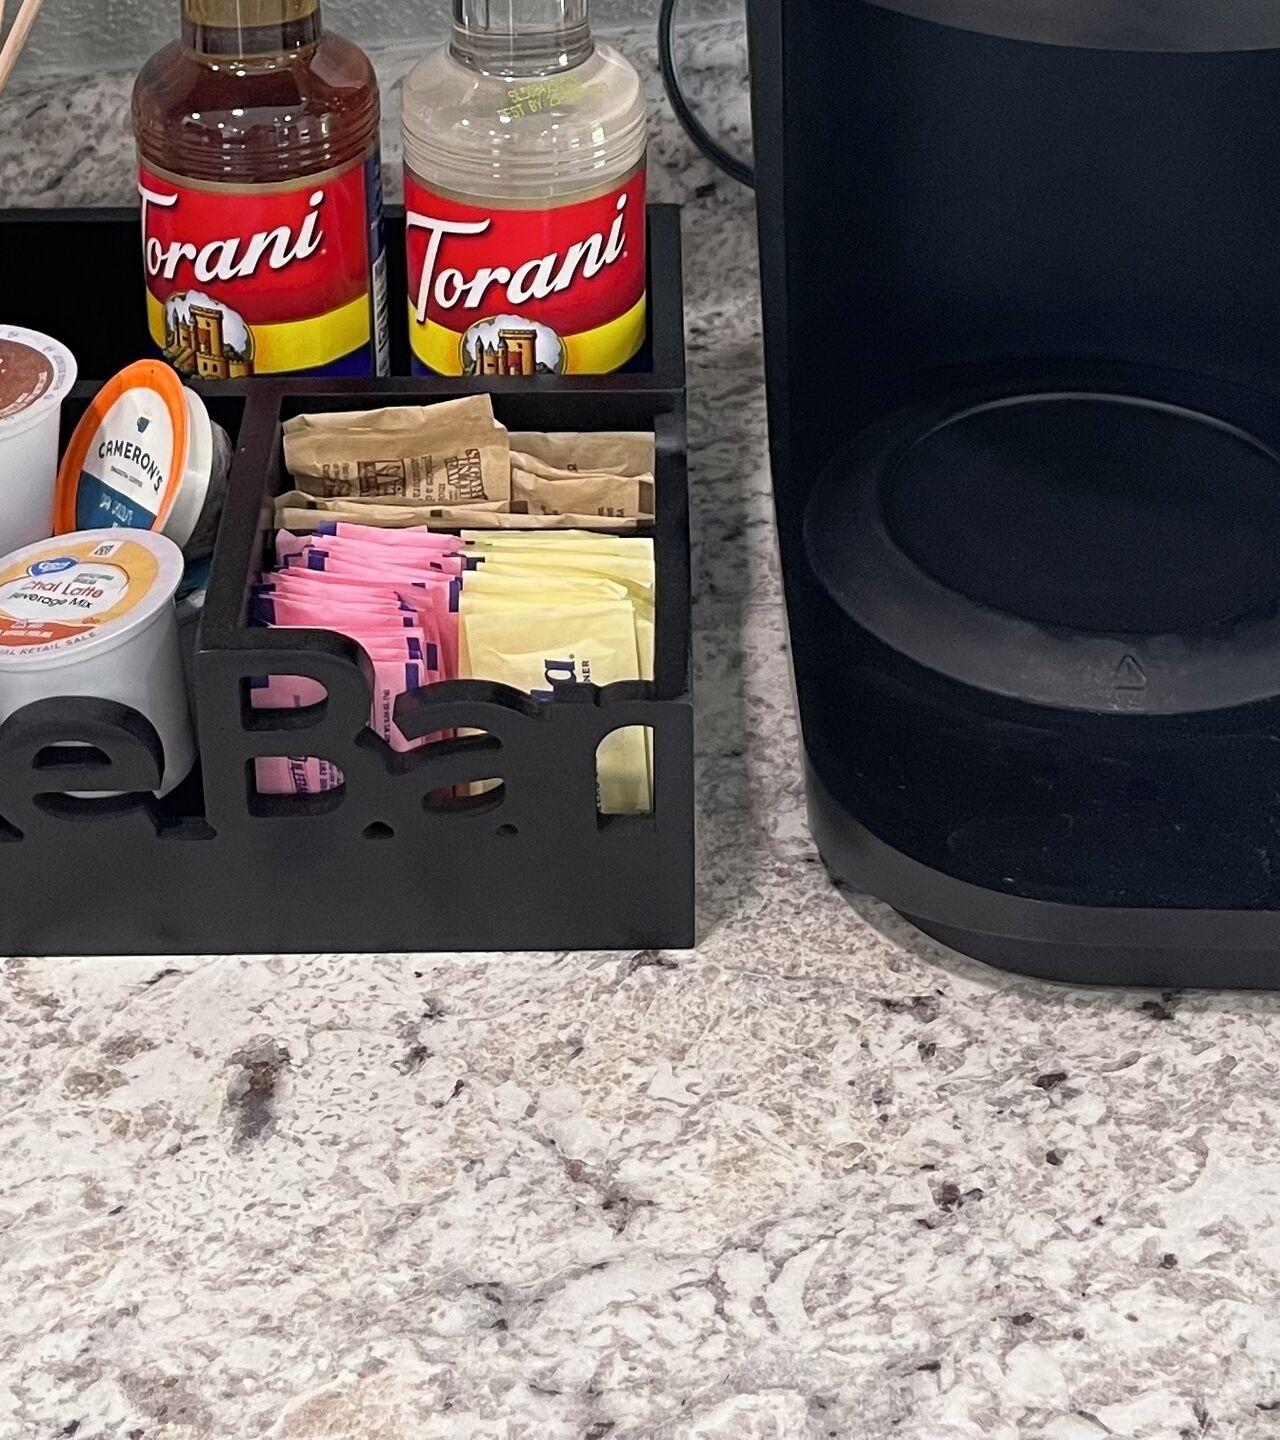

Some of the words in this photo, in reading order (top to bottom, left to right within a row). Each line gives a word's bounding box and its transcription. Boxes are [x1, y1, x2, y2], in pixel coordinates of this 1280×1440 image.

[138, 182, 325, 283] Torani
[406, 193, 628, 325] Torani
[98, 439, 164, 494] CAMERON'S
[458, 477, 471, 500] TH
[465, 448, 489, 501] SUGAR
[61, 582, 104, 599] Latte
[68, 597, 95, 609] Mix
[20, 644, 62, 656] RETAIL
[65, 632, 98, 647] SALE
[197, 626, 695, 846] Bar
